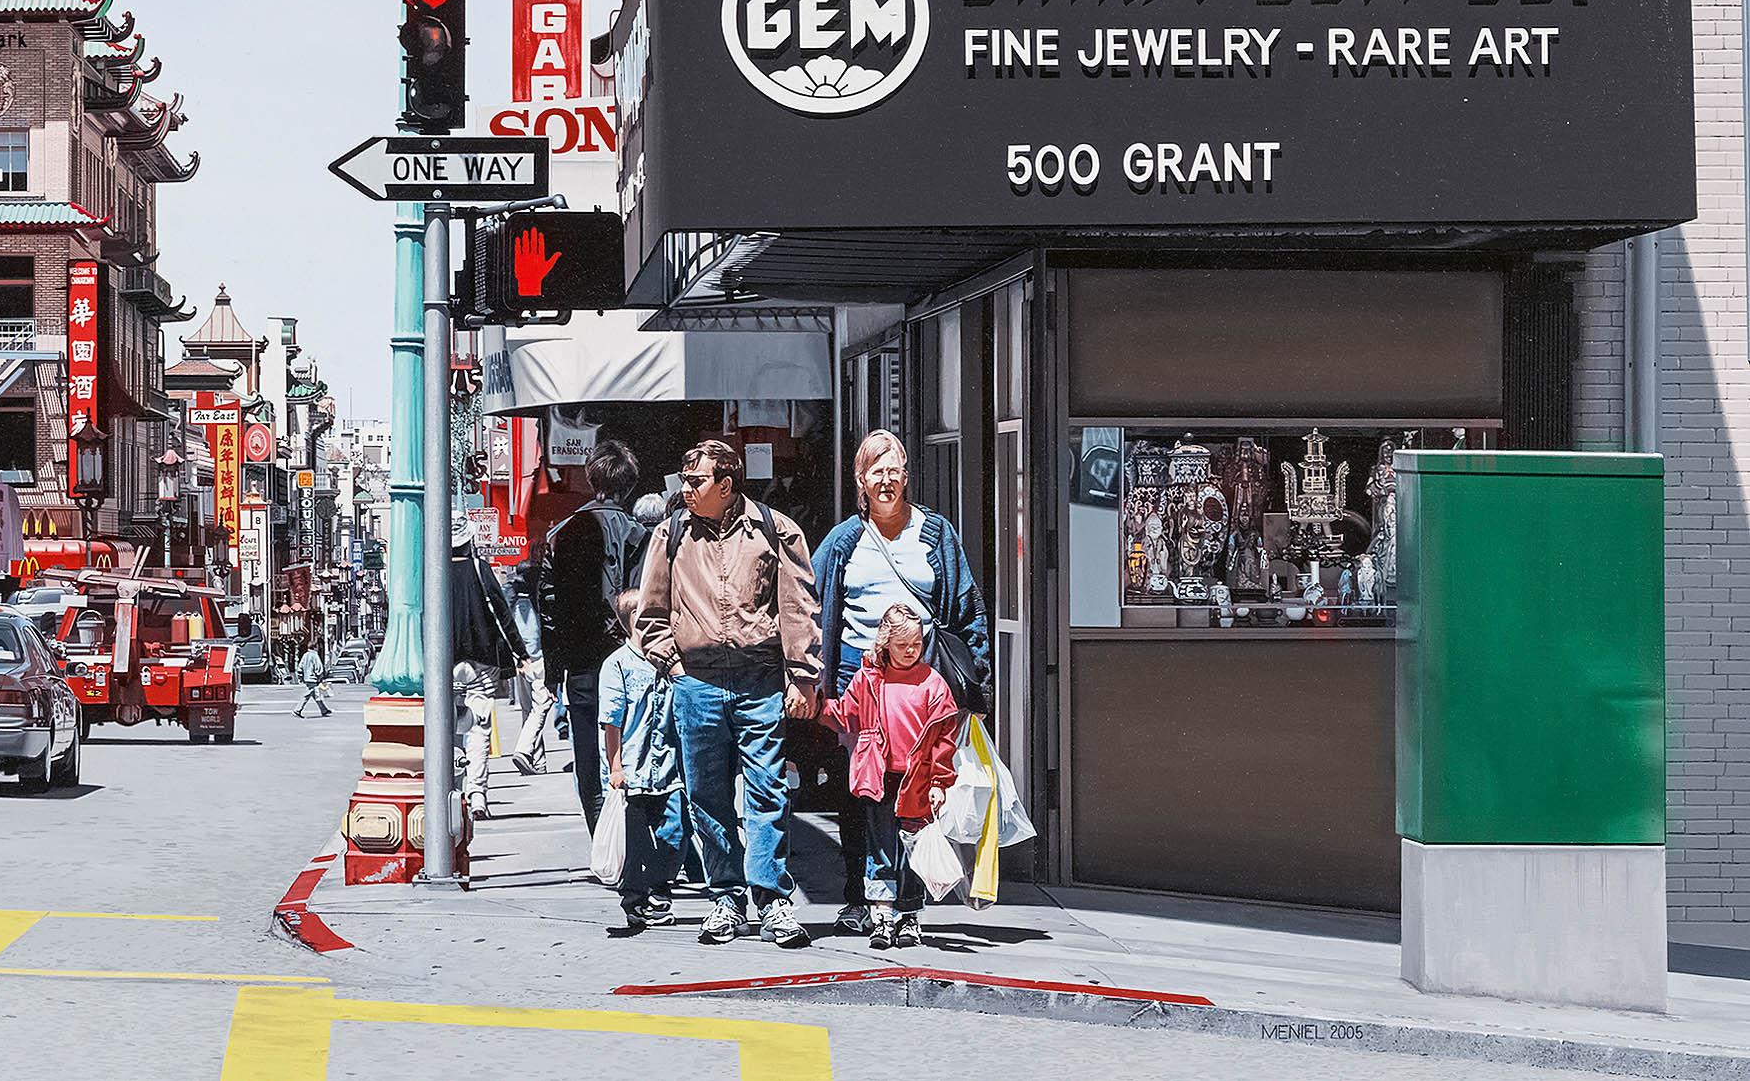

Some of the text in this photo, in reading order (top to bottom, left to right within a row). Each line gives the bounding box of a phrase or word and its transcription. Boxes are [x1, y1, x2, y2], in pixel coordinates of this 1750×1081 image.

[964, 27, 1559, 66] FINE JEWELRY RARE ART
[392, 155, 524, 182] ONE WAY
[1007, 142, 1280, 185] 500 GRANT
[212, 410, 236, 420] East
[565, 439, 583, 447] SAN
[301, 488, 314, 530] FOUR
[479, 524, 491, 532] ANY
[478, 533, 492, 541] TIME
[1261, 1024, 1364, 1040] MENIEL 2005
